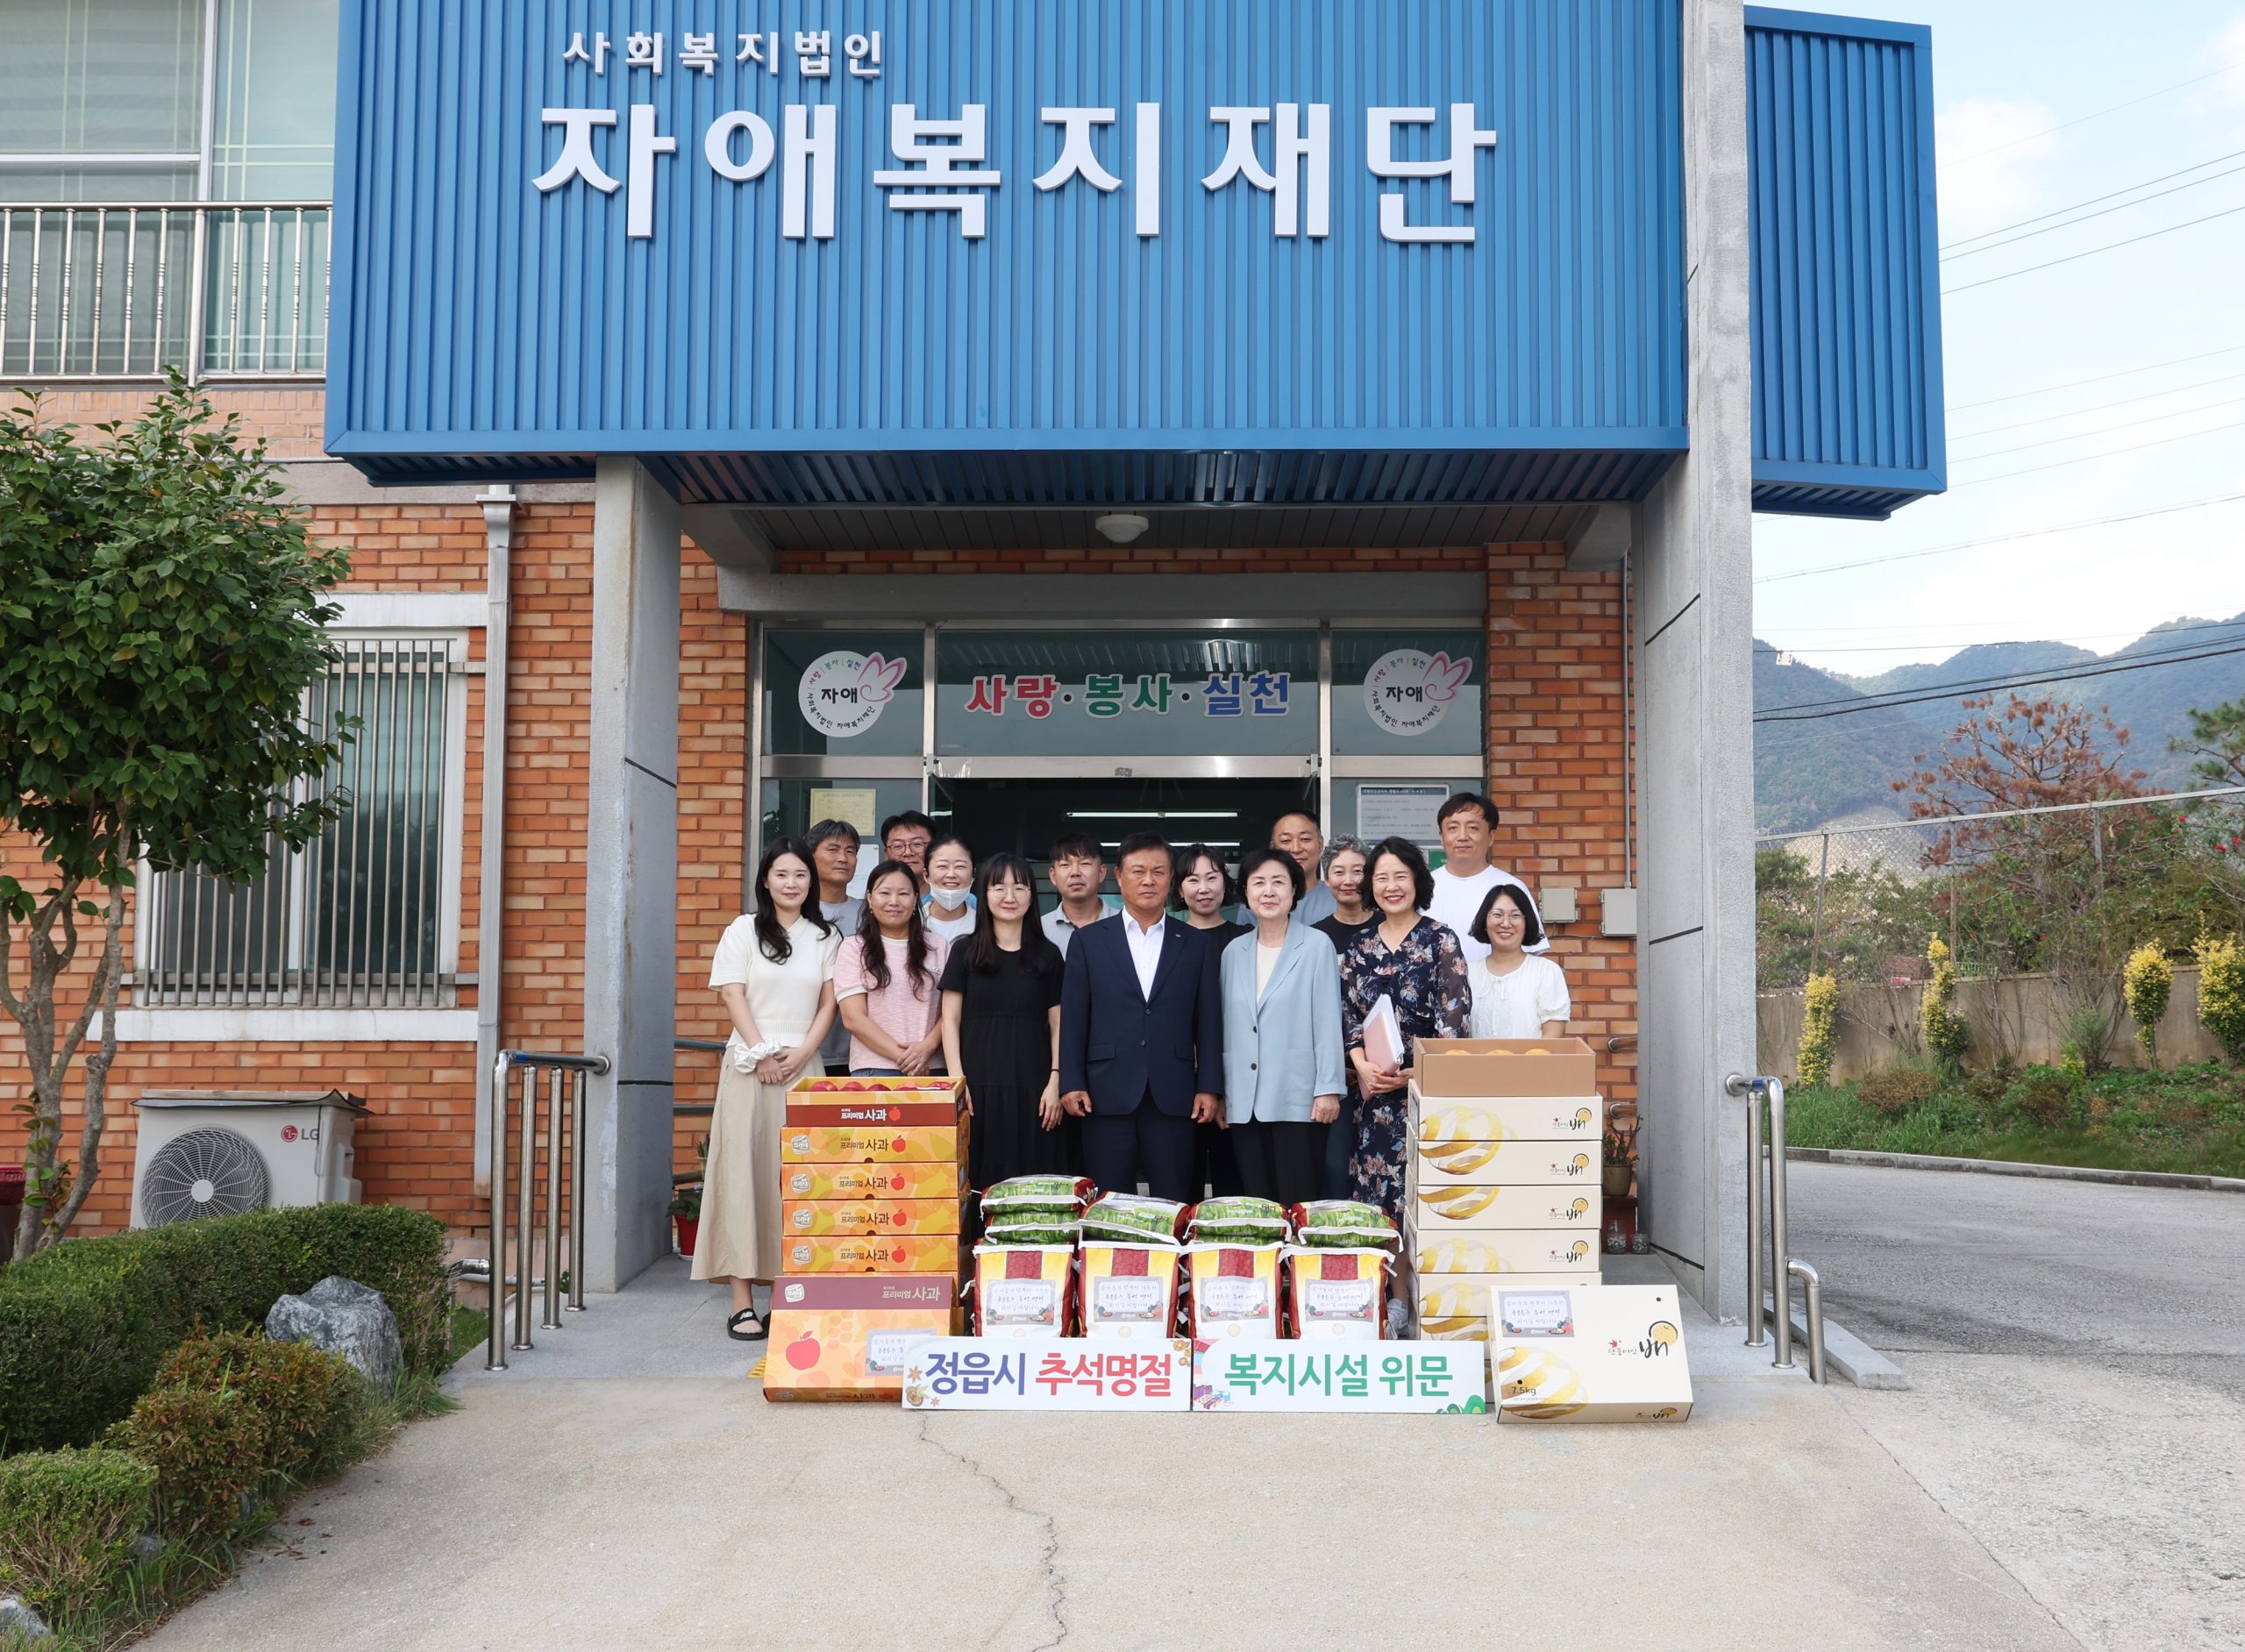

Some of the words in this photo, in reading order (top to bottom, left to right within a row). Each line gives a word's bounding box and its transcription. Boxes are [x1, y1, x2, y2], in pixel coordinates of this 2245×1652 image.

[562, 30, 881, 78] 사회복지법인
[531, 103, 1497, 243] 자애복지재단
[821, 687, 859, 704] 자애
[1385, 686, 1423, 703] 자애
[864, 1107, 887, 1122] 사과
[301, 1128, 319, 1141] LG
[840, 1141, 865, 1150] 프리미엄
[865, 1137, 889, 1151] 사과
[838, 1179, 864, 1188] 프리미엄
[864, 1176, 888, 1189] 사과
[866, 1212, 890, 1225] 사과
[865, 1249, 889, 1262] 사과
[882, 1290, 911, 1299] 프리미엄
[911, 1286, 941, 1301] 사과
[924, 1351, 1026, 1396] 정읍시
[1035, 1352, 1172, 1397] 추석명절
[1224, 1353, 1369, 1397] 복지시설
[1379, 1354, 1453, 1397] 위문
[1511, 1385, 1536, 1396] 7.5kg
